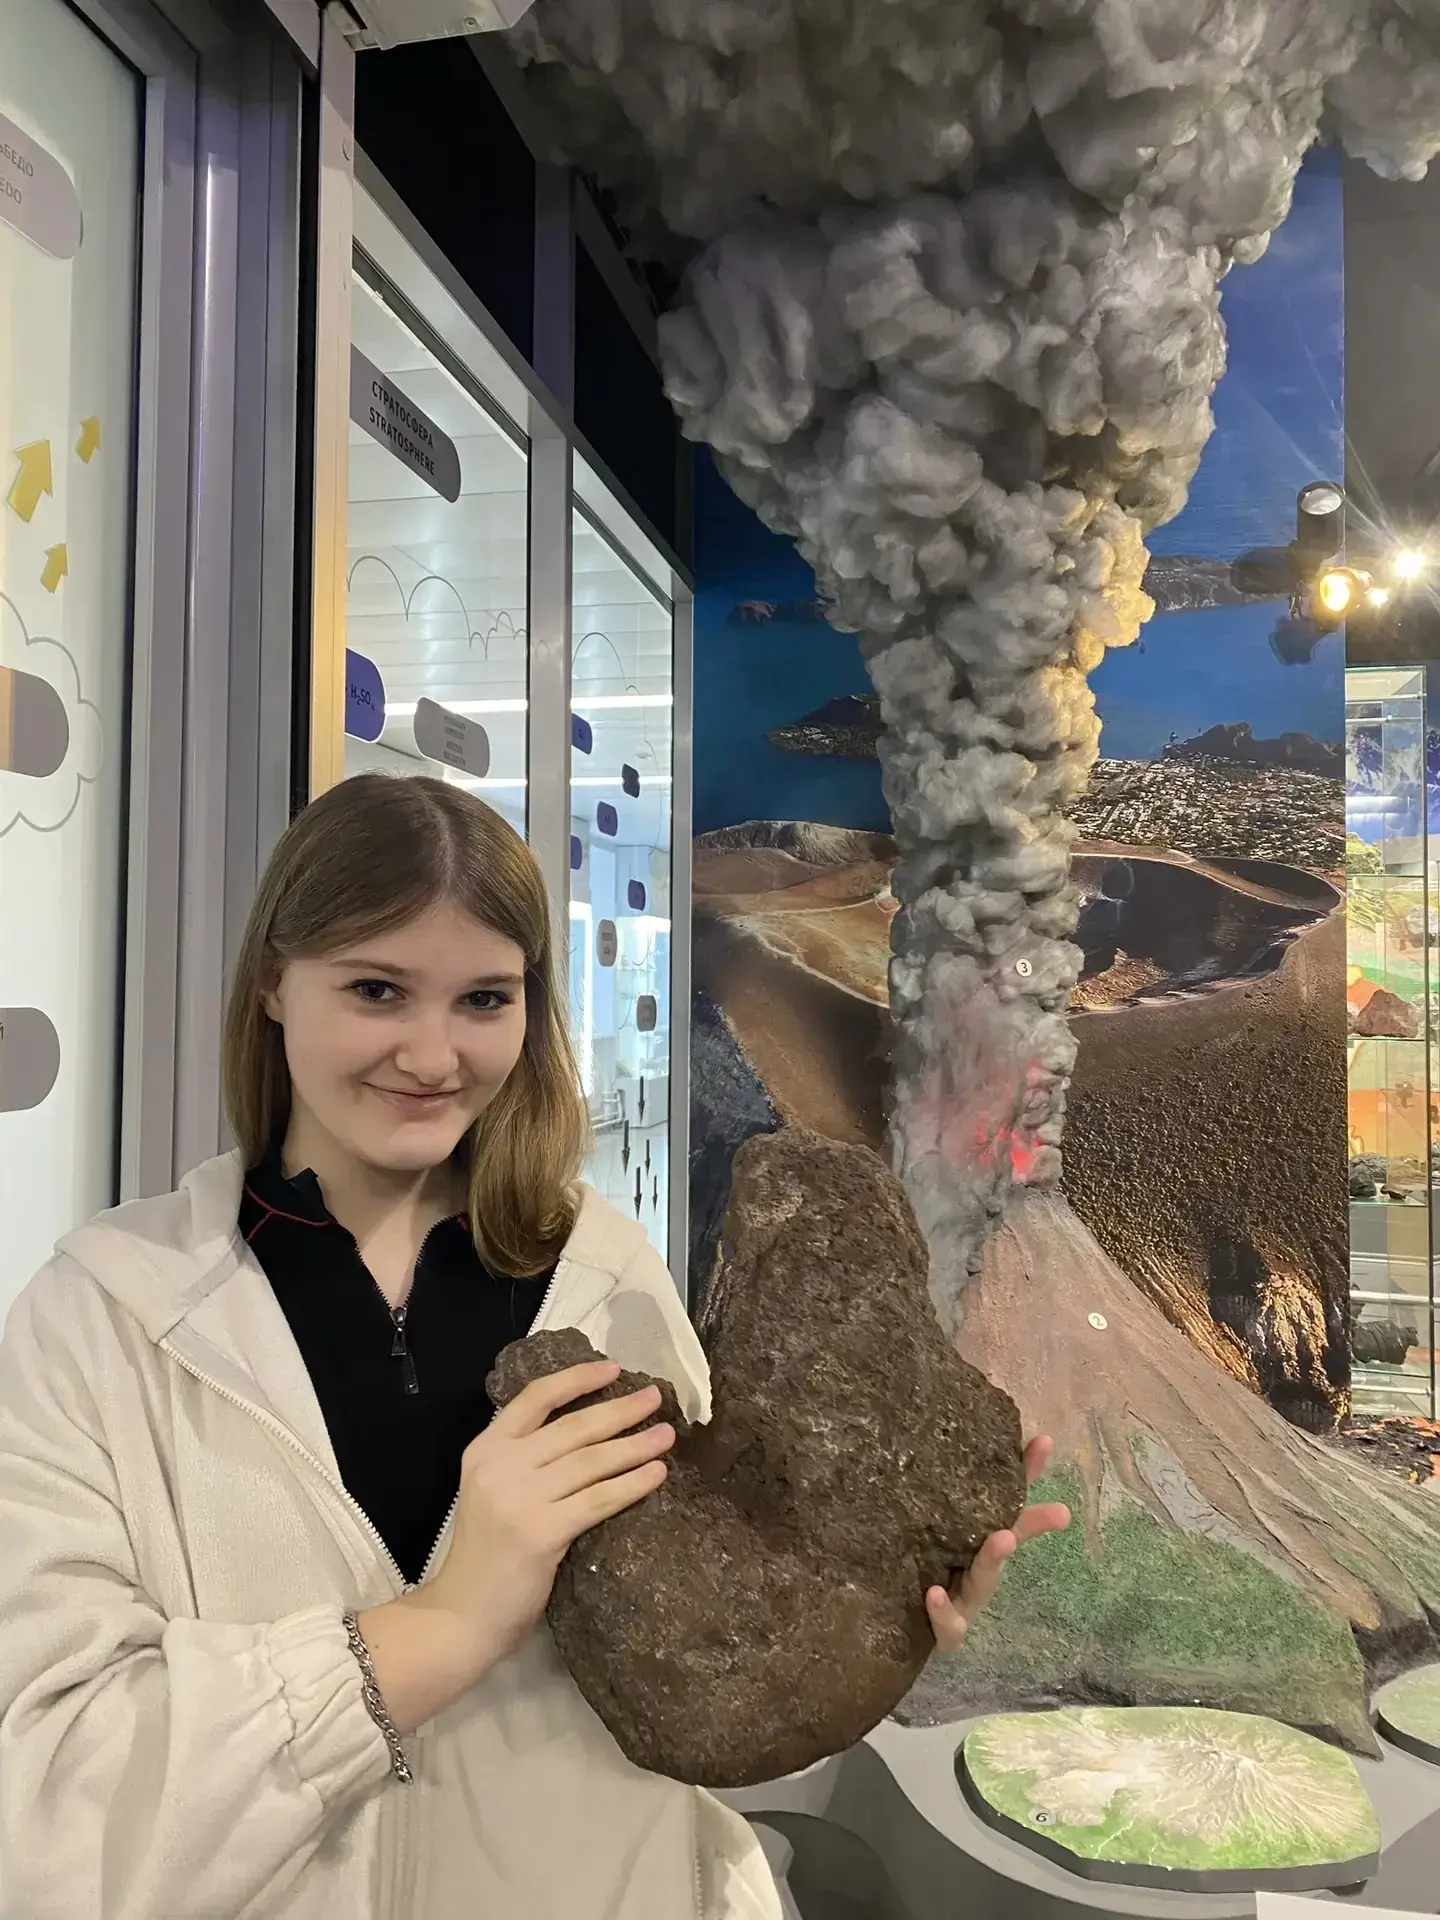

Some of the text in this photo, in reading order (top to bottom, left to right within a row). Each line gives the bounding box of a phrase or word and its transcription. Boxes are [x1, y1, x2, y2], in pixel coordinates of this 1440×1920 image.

[372, 380, 434, 448] СТРАТОСФЕРА
[369, 406, 435, 476] STRATOSPHERE
[1020, 962, 1028, 973] 3
[1092, 1316, 1104, 1327] 2
[1035, 1812, 1048, 1823] 6
